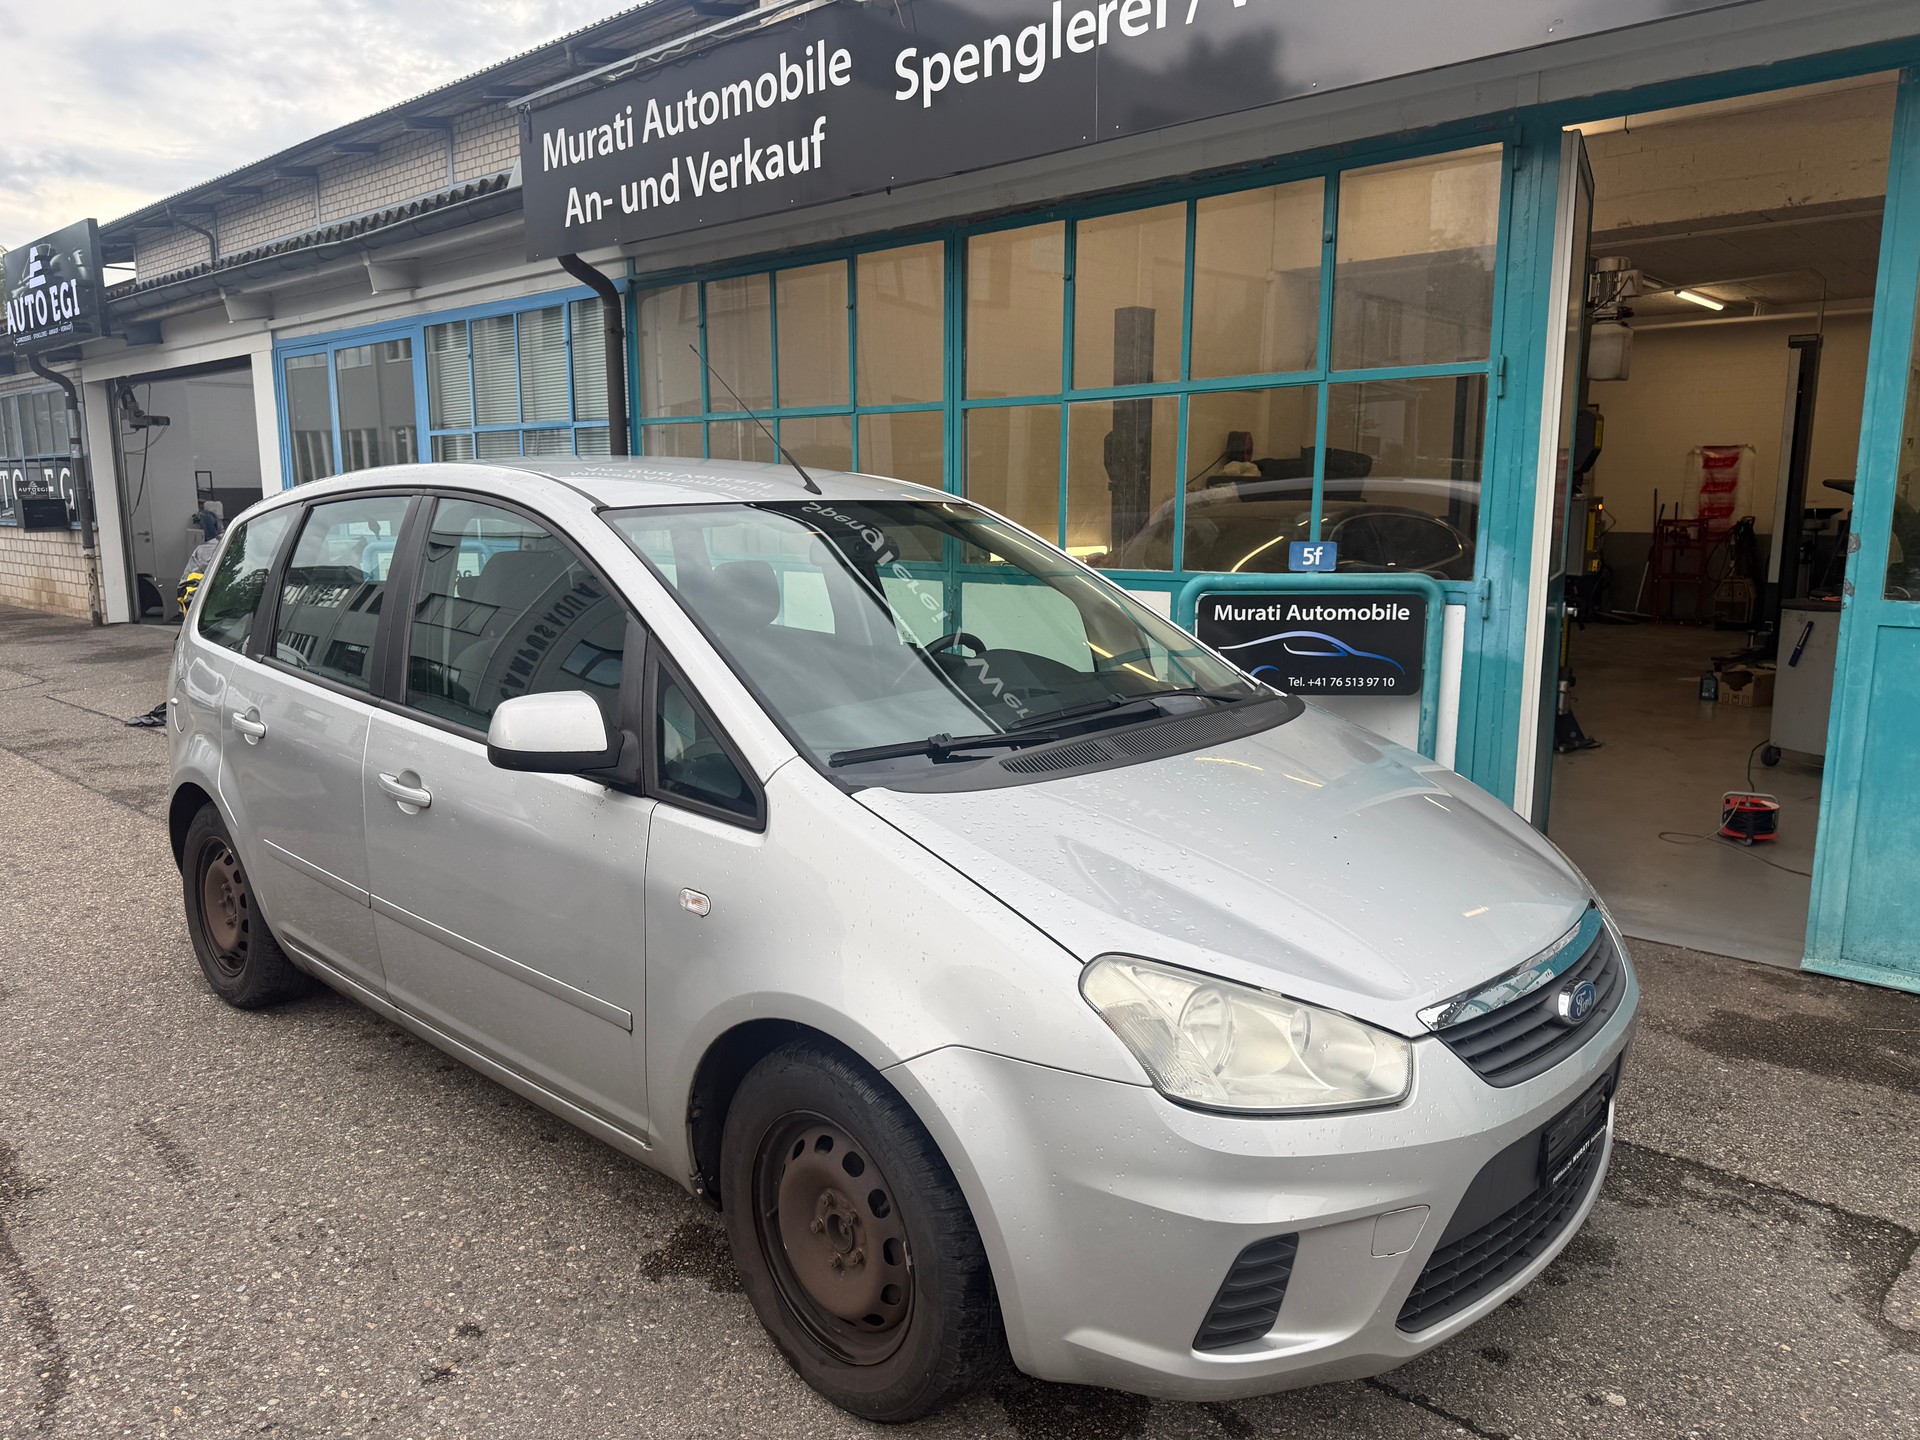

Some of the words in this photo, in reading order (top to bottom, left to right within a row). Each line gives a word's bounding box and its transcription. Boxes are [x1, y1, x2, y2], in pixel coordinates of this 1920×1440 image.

[543, 105, 634, 172] Murati
[642, 39, 852, 144] Automobile
[565, 187, 613, 228] An-
[620, 157, 680, 215] und
[686, 116, 827, 198] Verkauf
[7, 290, 48, 335] AUTO
[49, 278, 81, 322] EGI
[1302, 546, 1324, 566] 5f
[1214, 604, 1282, 621] Murati
[1286, 603, 1411, 621] Automobile
[1288, 676, 1306, 687] Tel.
[1307, 677, 1326, 687] +41
[1330, 677, 1343, 687] 76
[1345, 677, 1364, 687] 513
[1366, 677, 1380, 687] 97
[1383, 677, 1395, 687] 10
